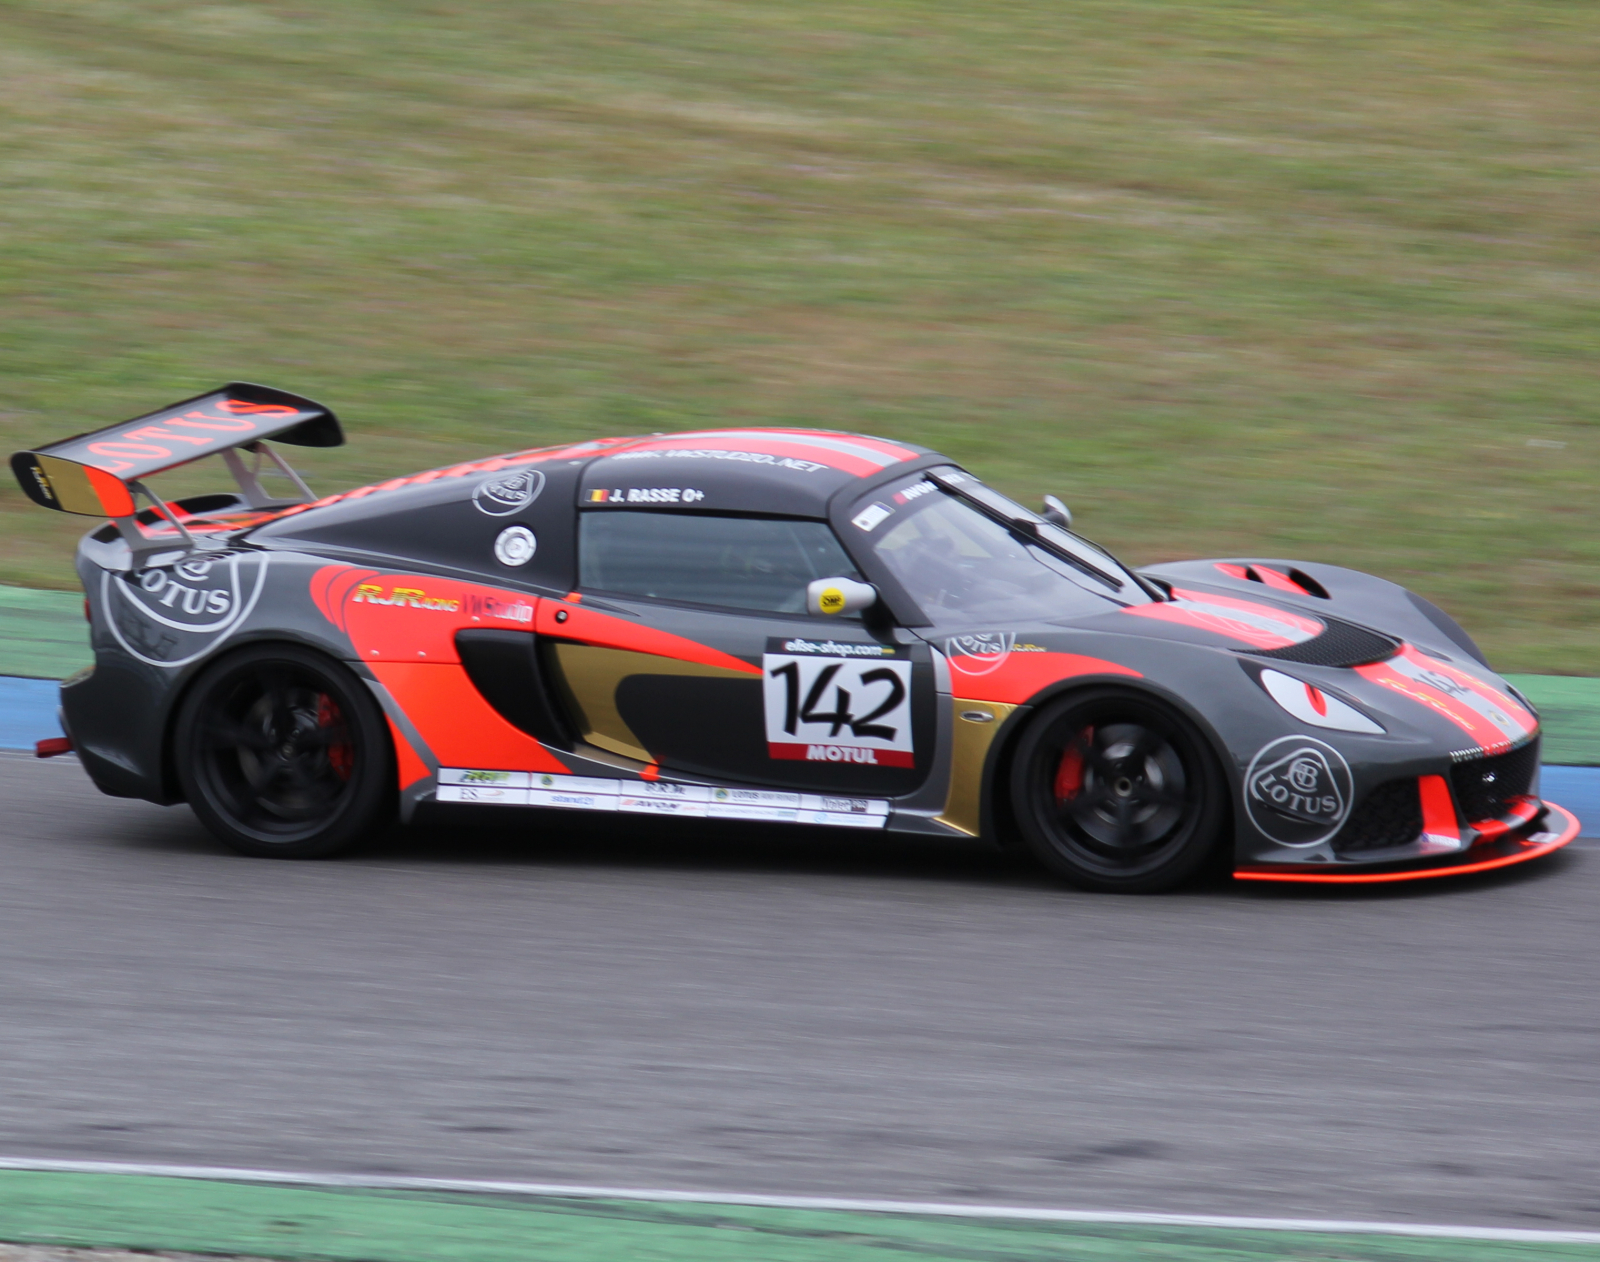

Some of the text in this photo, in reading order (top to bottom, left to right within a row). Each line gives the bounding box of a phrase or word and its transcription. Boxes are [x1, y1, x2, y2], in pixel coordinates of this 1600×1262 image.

[87, 398, 300, 473] LOTUS
[627, 488, 681, 503] RASSE
[136, 568, 231, 615] OTUS
[784, 638, 883, 657] elise-shop.com
[770, 660, 906, 742] 142
[806, 745, 878, 765] MOTUL
[1257, 773, 1338, 814] LOTUS
